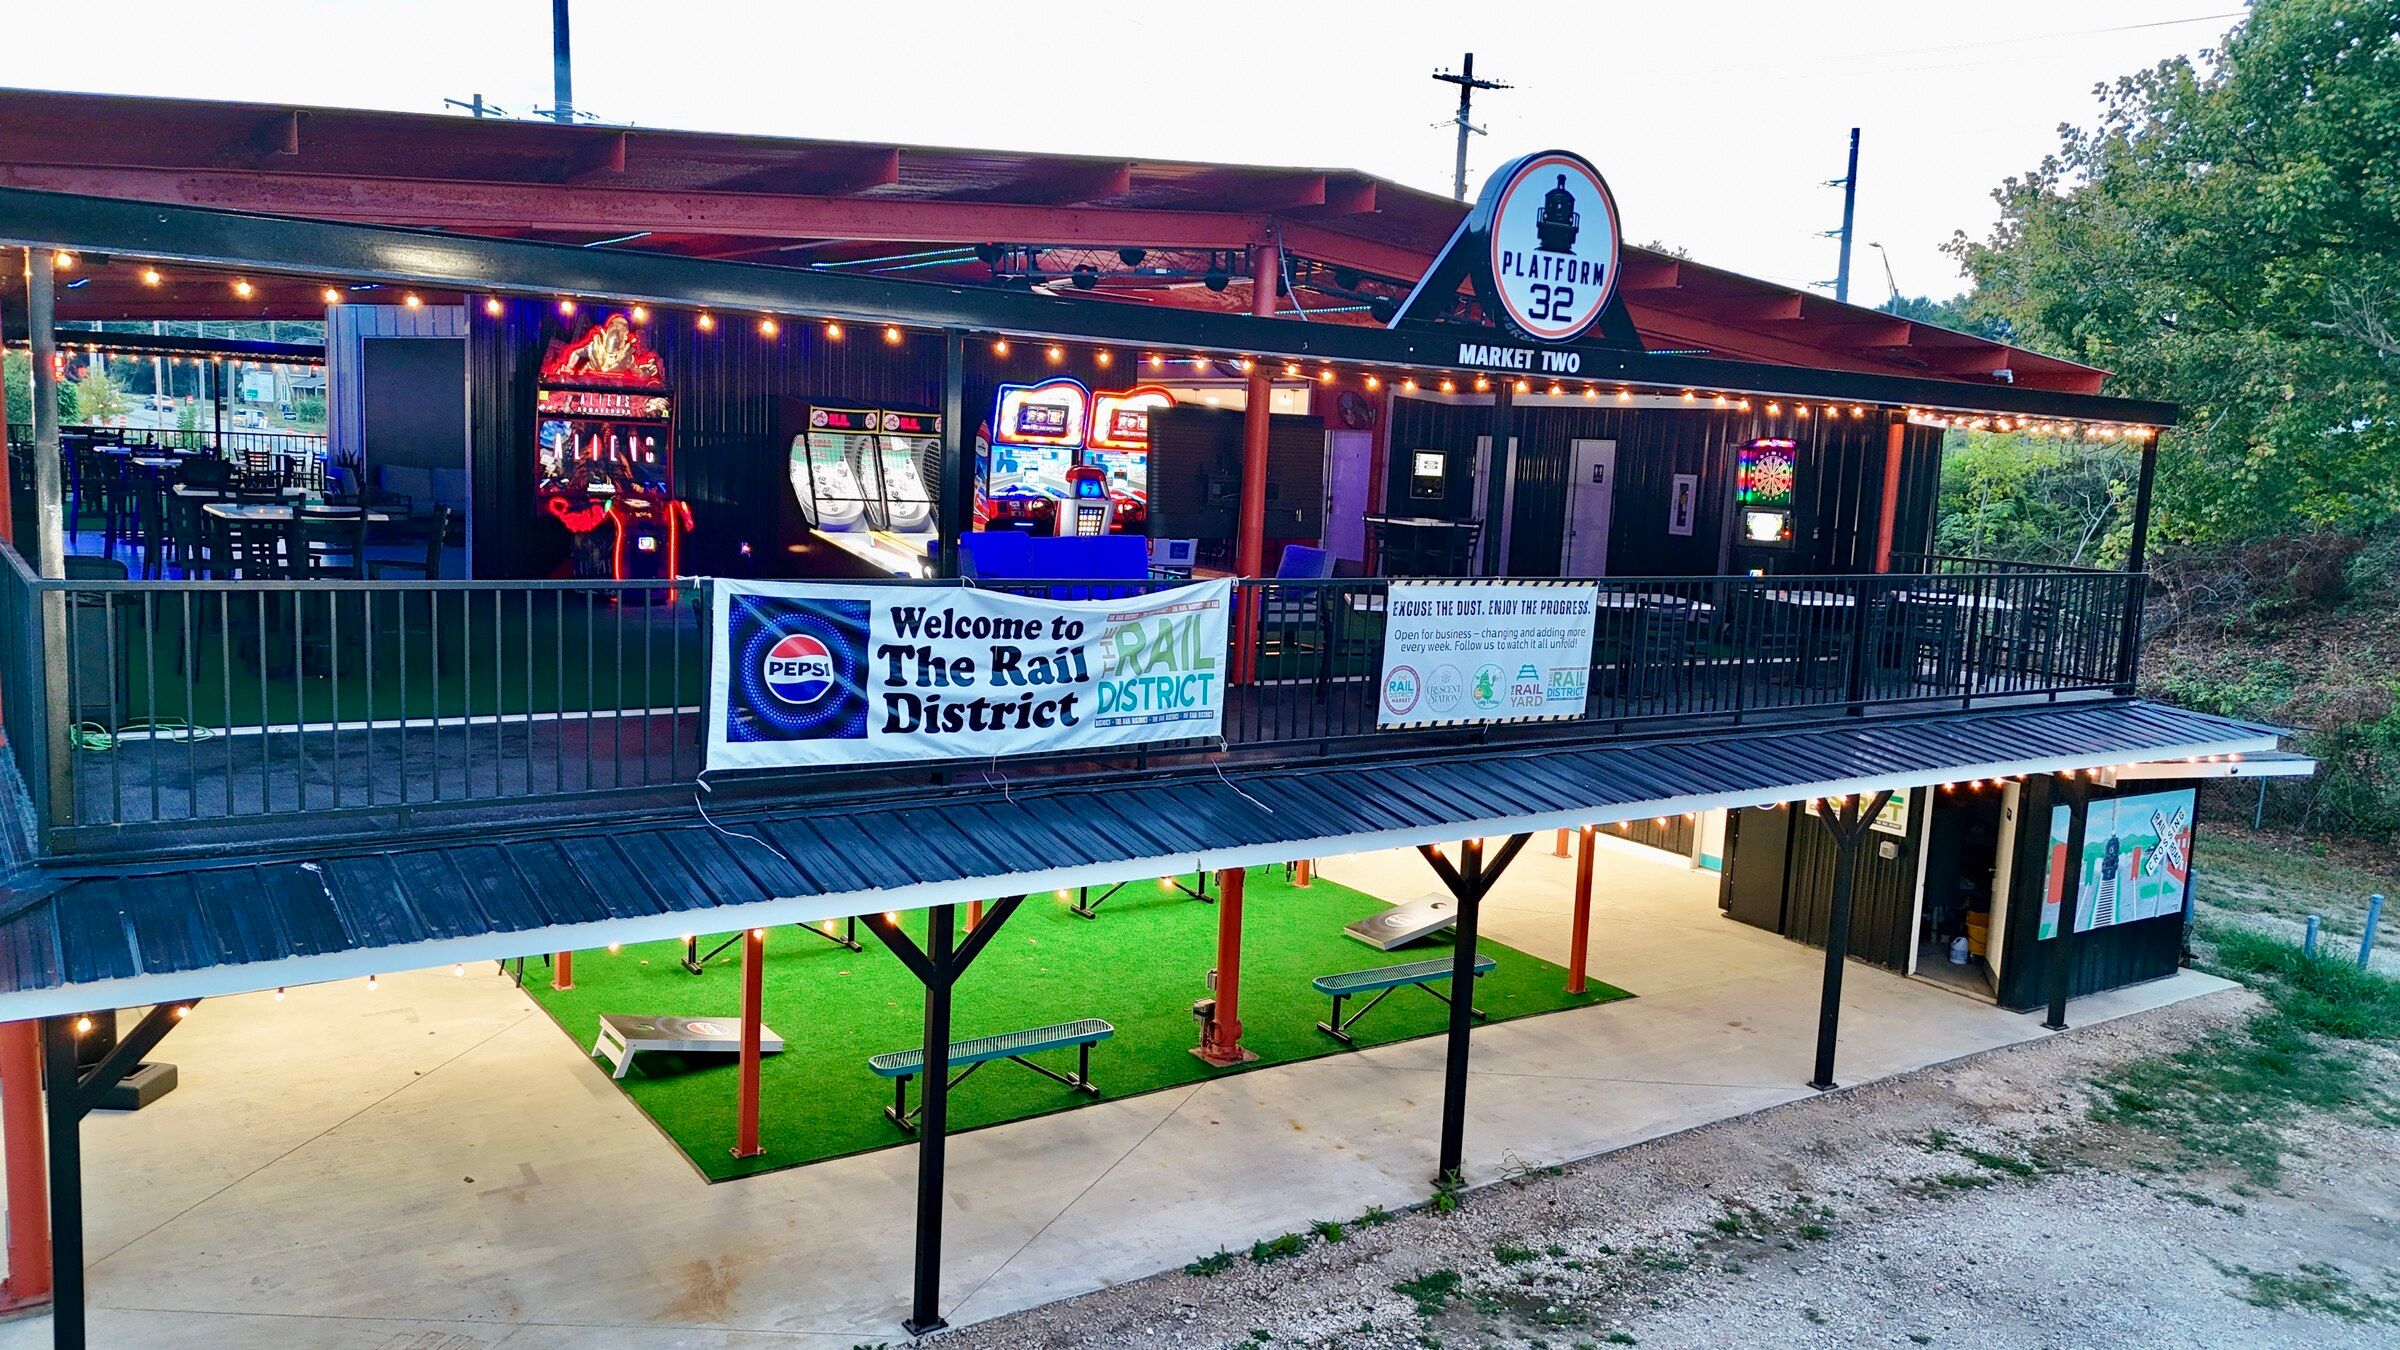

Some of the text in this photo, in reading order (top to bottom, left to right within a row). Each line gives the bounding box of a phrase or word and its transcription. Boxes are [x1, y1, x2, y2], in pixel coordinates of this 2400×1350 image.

[1502, 250, 1605, 287] PLATFORM
[1528, 283, 1574, 323] 32
[1458, 343, 1581, 373] MARKET TWO
[580, 393, 630, 407] ALIENS
[554, 432, 655, 464] ALIENS
[889, 606, 1084, 641] Welcome to
[1392, 599, 1591, 617] EXCUSE THE DUST. ENJOY THE PROGRESS.
[1115, 613, 1216, 676] RAIL
[1394, 629, 1419, 642] Open
[1421, 628, 1434, 640] for
[1435, 628, 1472, 640] business
[1481, 627, 1519, 640] changing
[1520, 627, 1535, 638] and
[1536, 626, 1565, 639] adding
[1566, 628, 1586, 637] more
[1400, 638, 1578, 654] every week. Follow us to watch it all unfold!
[877, 643, 1091, 688] The Rail
[1099, 627, 1118, 679] THE
[768, 660, 831, 678] PEPSI
[1552, 671, 1586, 688] RAIL
[1097, 673, 1215, 715] DISTRICT
[1389, 681, 1414, 692] RAIL
[1511, 696, 1544, 708] YARD
[1515, 684, 1544, 696] RAIL
[1546, 686, 1585, 698] DISTRICT
[881, 691, 1080, 734] District
[2148, 811, 2185, 871] CROSSING
[2154, 812, 2181, 865] RAIL ROAD
